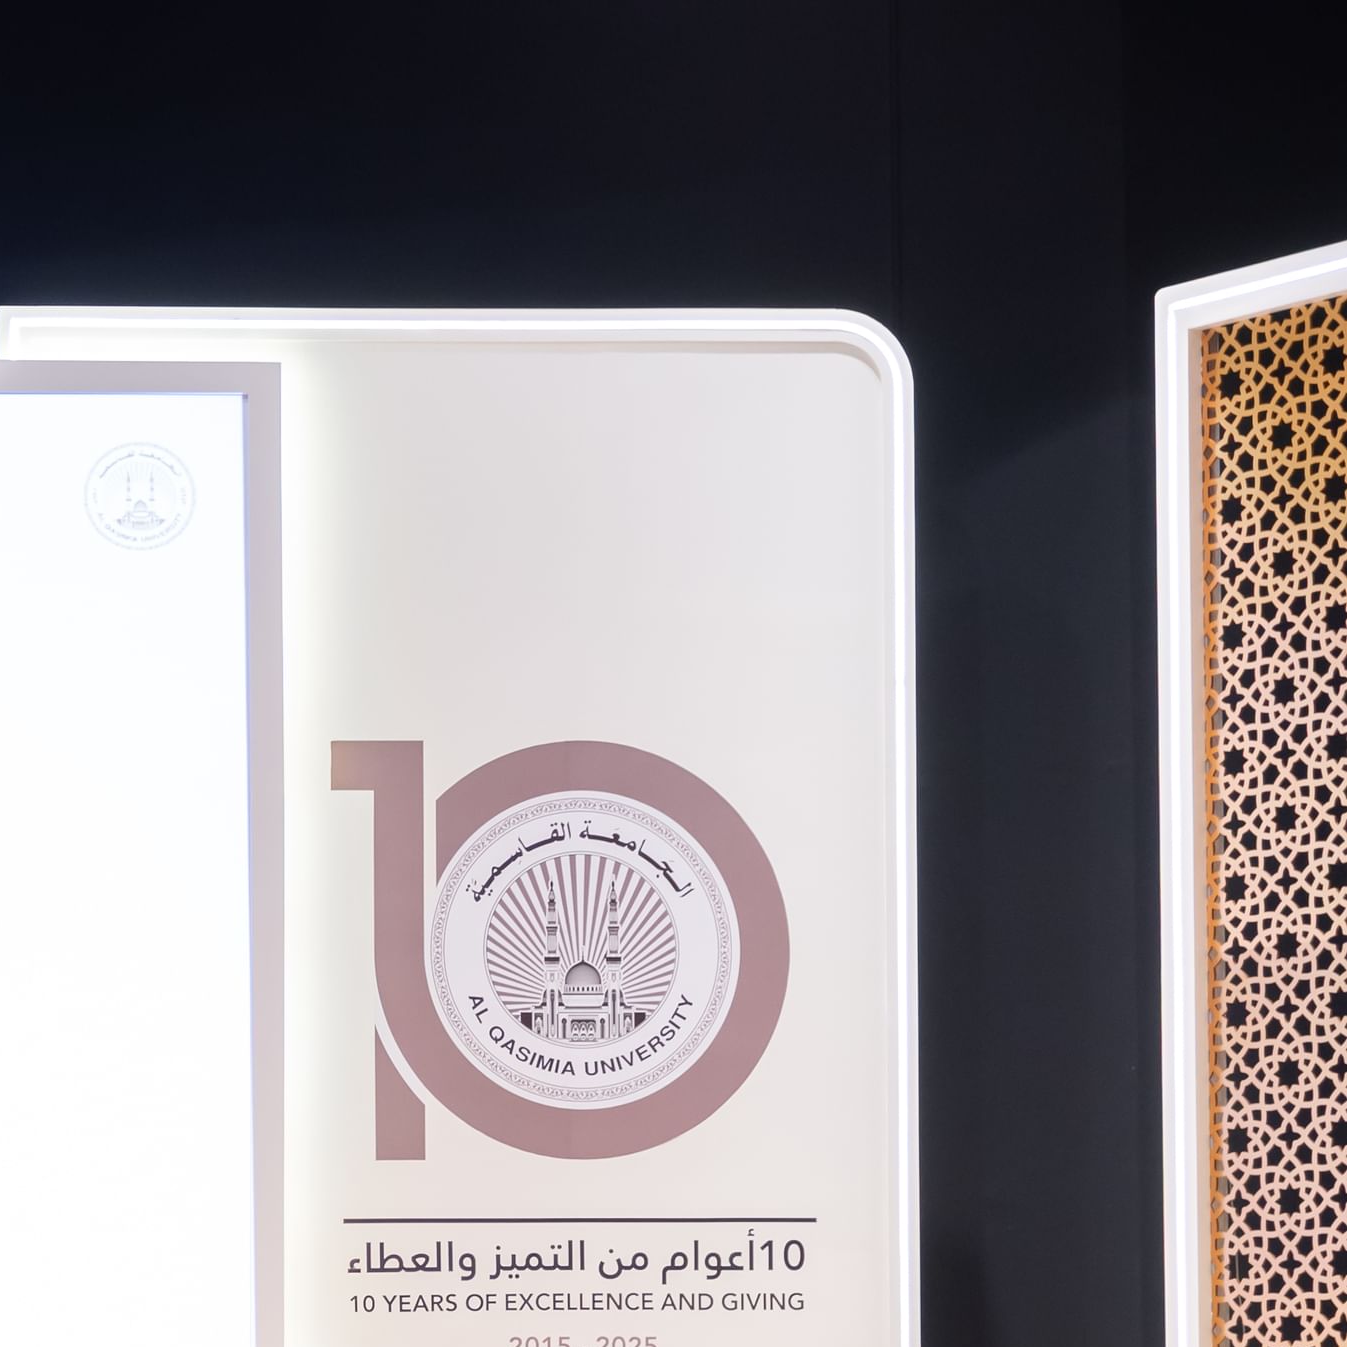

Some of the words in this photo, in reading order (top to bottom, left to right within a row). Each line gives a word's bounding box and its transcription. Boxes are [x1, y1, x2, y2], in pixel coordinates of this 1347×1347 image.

[468, 995, 489, 1024] AL
[489, 1025, 576, 1076] QASIMIA
[584, 994, 693, 1076] UNIVERSITY
[347, 1240, 477, 1282] والعطاء
[489, 1239, 586, 1281] التميز
[598, 1248, 649, 1280] من
[350, 1294, 376, 1313] 10
[382, 1293, 458, 1313] YEARS
[465, 1293, 498, 1312] OF
[505, 1292, 655, 1312] EXCELLENCE
[660, 1292, 715, 1311] AND
[721, 1292, 806, 1311] GIVING
